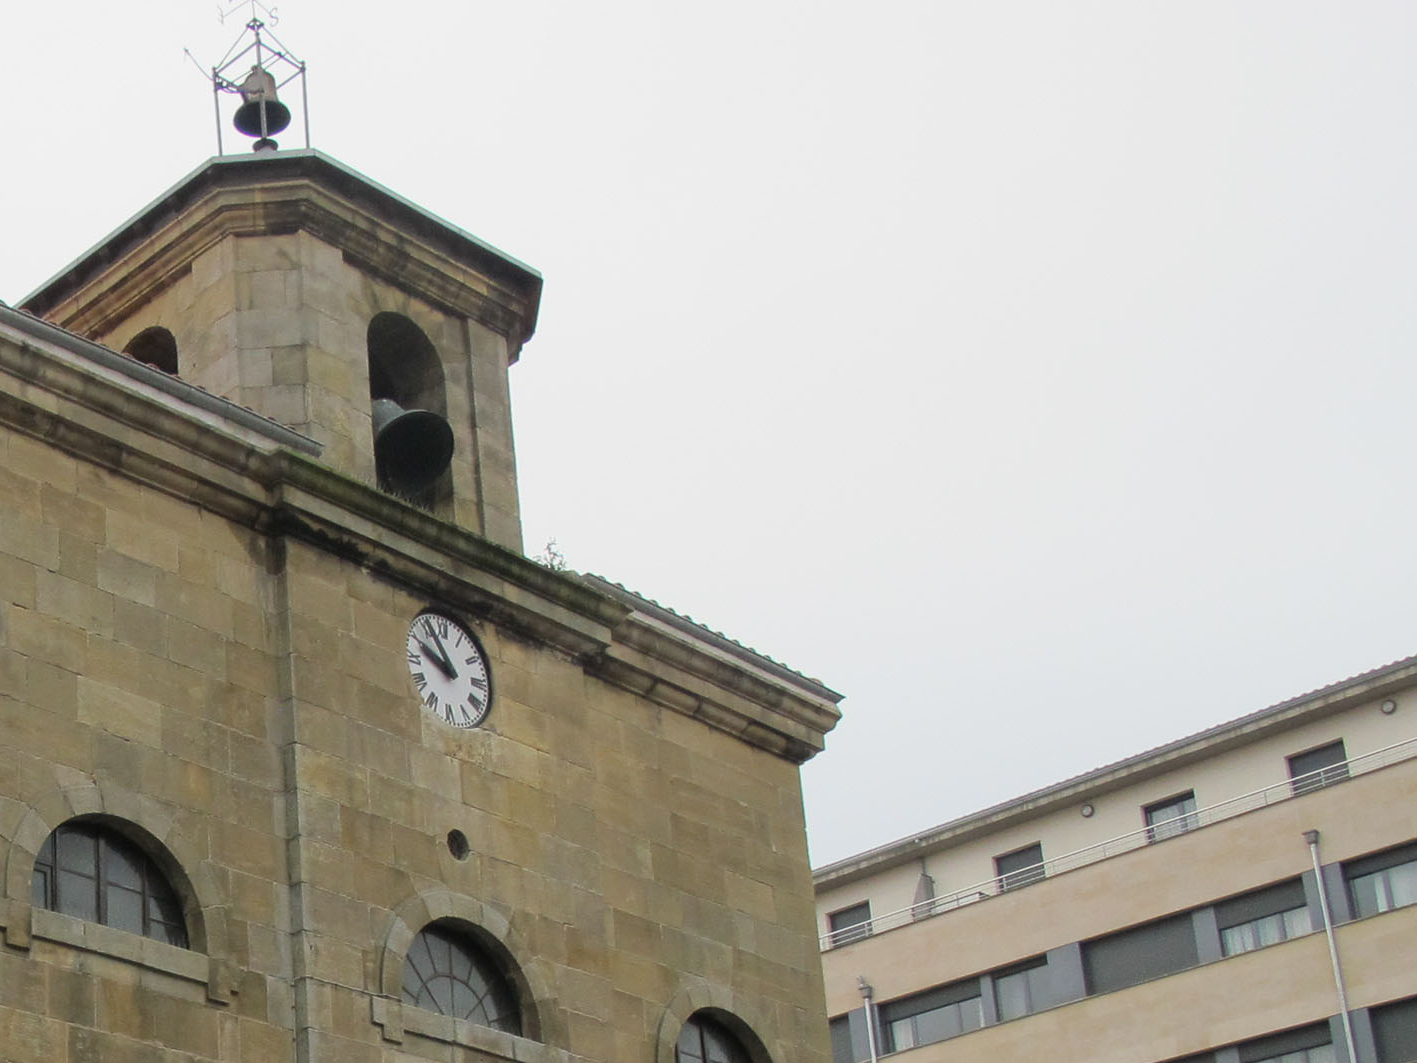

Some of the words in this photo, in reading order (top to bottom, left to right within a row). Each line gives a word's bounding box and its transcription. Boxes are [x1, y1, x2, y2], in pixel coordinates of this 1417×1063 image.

[455, 632, 464, 648] I
[407, 649, 421, 665] IX
[465, 656, 479, 665] II
[412, 672, 427, 691] VIII
[470, 677, 486, 690] III
[425, 692, 438, 711] VII
[445, 704, 455, 723] VI
[460, 704, 470, 721] V
